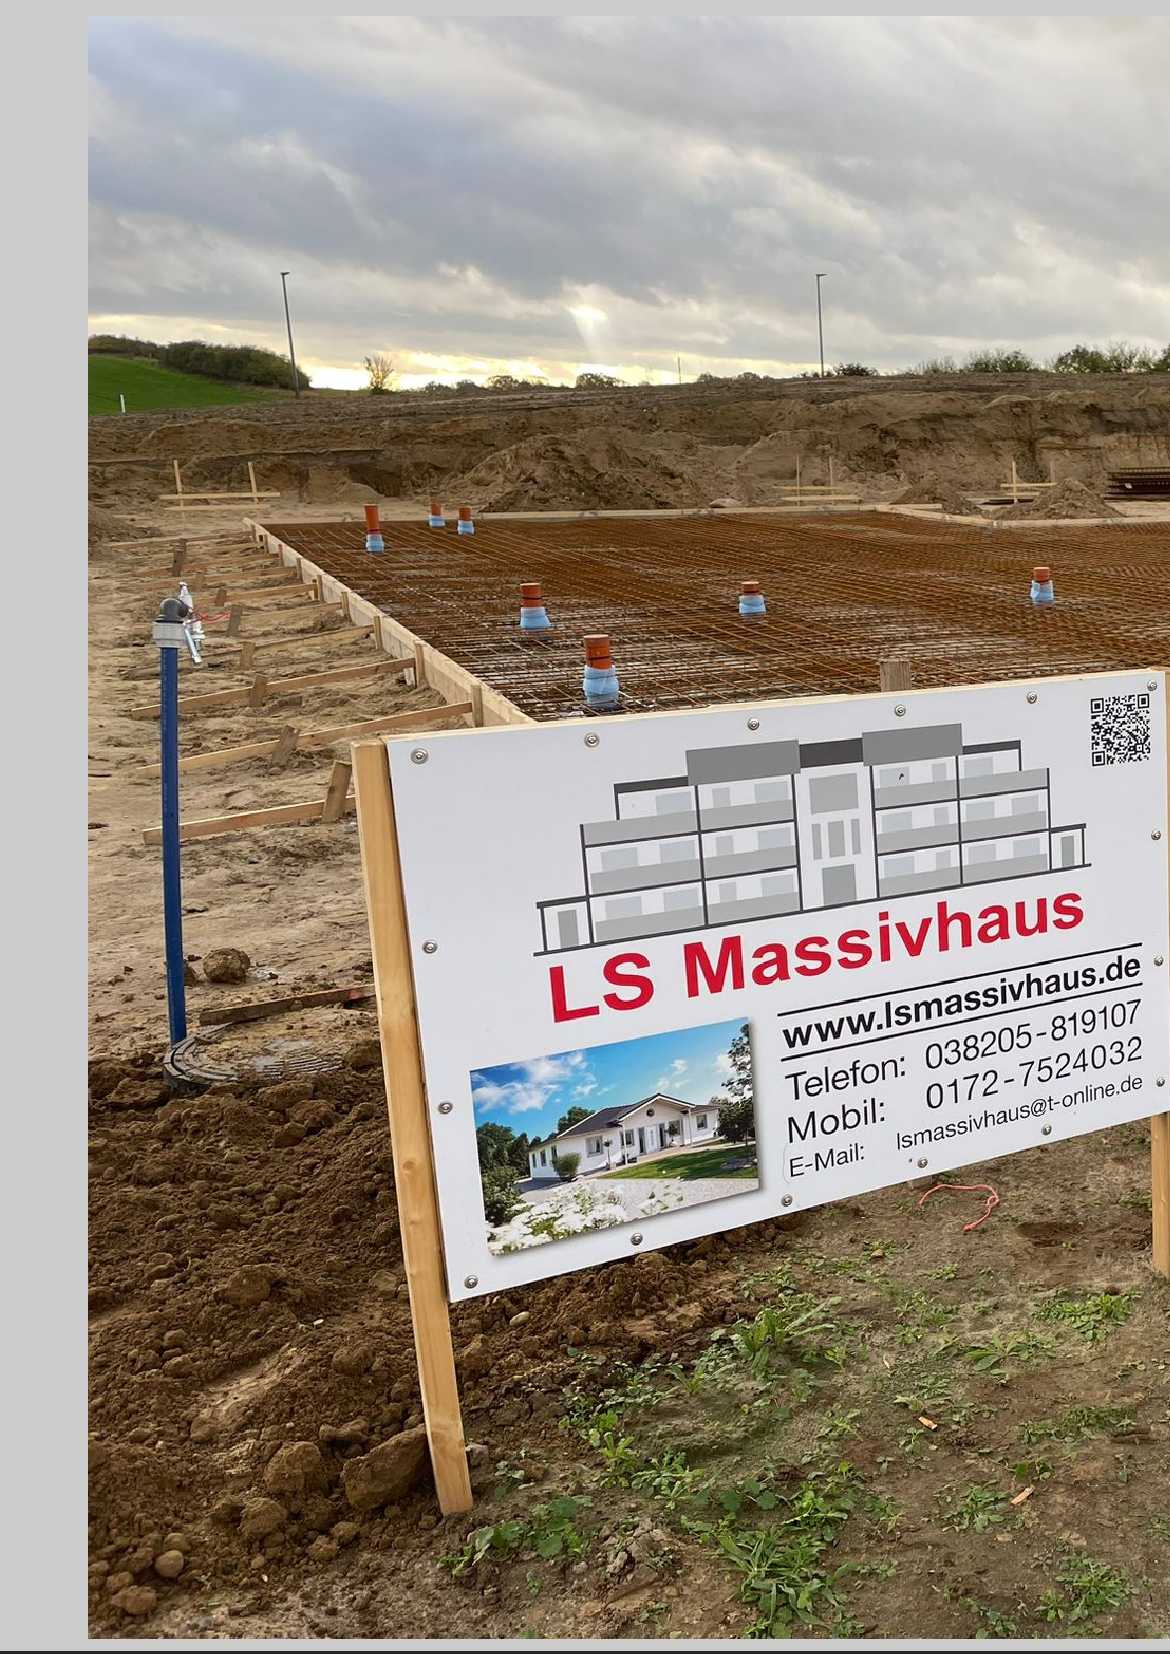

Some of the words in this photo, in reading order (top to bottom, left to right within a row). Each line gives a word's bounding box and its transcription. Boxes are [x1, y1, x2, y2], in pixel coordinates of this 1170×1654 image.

[548, 952, 653, 1024] LS
[684, 891, 1085, 998] Massivhaus
[782, 954, 1142, 1050] www.lsmassivhaus.de
[785, 1055, 906, 1101] Telefon:
[788, 1097, 887, 1143] Mobil:
[789, 1144, 865, 1177] E-Mail:
[896, 1074, 1143, 1151] lsmassivhaus@t-online.de
